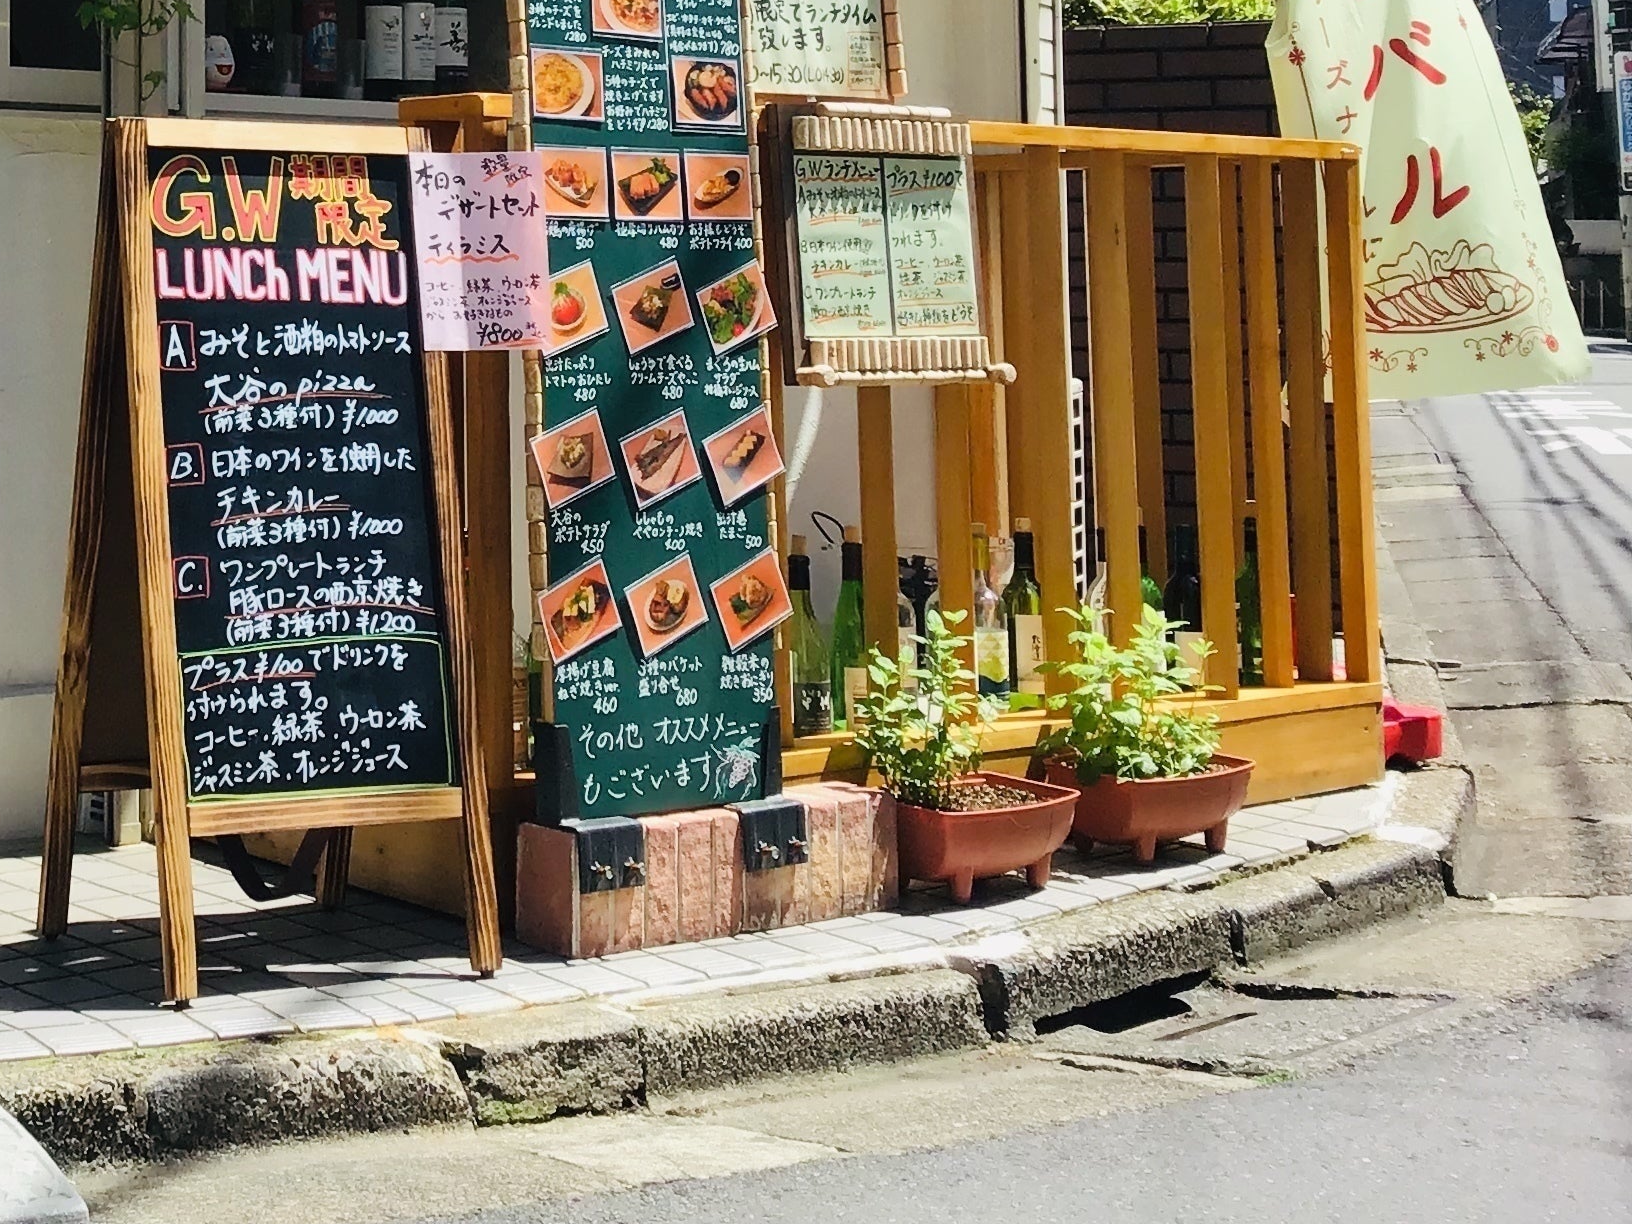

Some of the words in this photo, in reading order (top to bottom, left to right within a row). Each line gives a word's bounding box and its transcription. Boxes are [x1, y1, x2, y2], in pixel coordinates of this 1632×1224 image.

[720, 39, 740, 57] 780
[415, 159, 466, 197] 本日の
[151, 155, 284, 242] G.W
[289, 154, 370, 201] 期間
[438, 190, 542, 222] デザートセット
[314, 194, 400, 250] 限定
[428, 233, 511, 257] ティラミス
[575, 237, 594, 250] 500
[659, 237, 679, 249] 480
[689, 237, 733, 251] ポテトフライ
[734, 237, 753, 250] 400
[296, 248, 409, 305] MENU
[200, 318, 412, 359] みそと酒粕のトマトソース
[477, 321, 524, 347] ¥800
[628, 354, 693, 371] しょうゆで食べる
[545, 371, 612, 388] トマトのおひたし
[630, 371, 699, 386] クリームチーズやっこ
[713, 371, 741, 387] サラダ
[574, 387, 597, 401] 480
[662, 385, 684, 400] 480
[729, 395, 749, 410] 680
[212, 442, 417, 478] 日本のワインを使用した
[216, 485, 340, 524] チキンカレー
[551, 508, 582, 528] 大谷の
[635, 510, 675, 526] ししゃもの
[554, 520, 612, 544] ポテトサラダ
[719, 525, 747, 541] たまご
[744, 534, 763, 549] 500
[580, 538, 605, 554] 450
[220, 549, 387, 587] ワンプレートランチ
[229, 575, 424, 616] 豚ロースの西京焼き
[555, 656, 615, 684] 厚揚げ豆腐
[719, 670, 775, 690] 焼きおにぎり
[186, 680, 328, 721] 付けられます。
[592, 696, 618, 714] 460
[675, 687, 698, 707] 680
[752, 687, 774, 704] 350
[578, 723, 644, 759] その他
[653, 712, 761, 746] オススメメニュー
[583, 751, 713, 806] もございます
